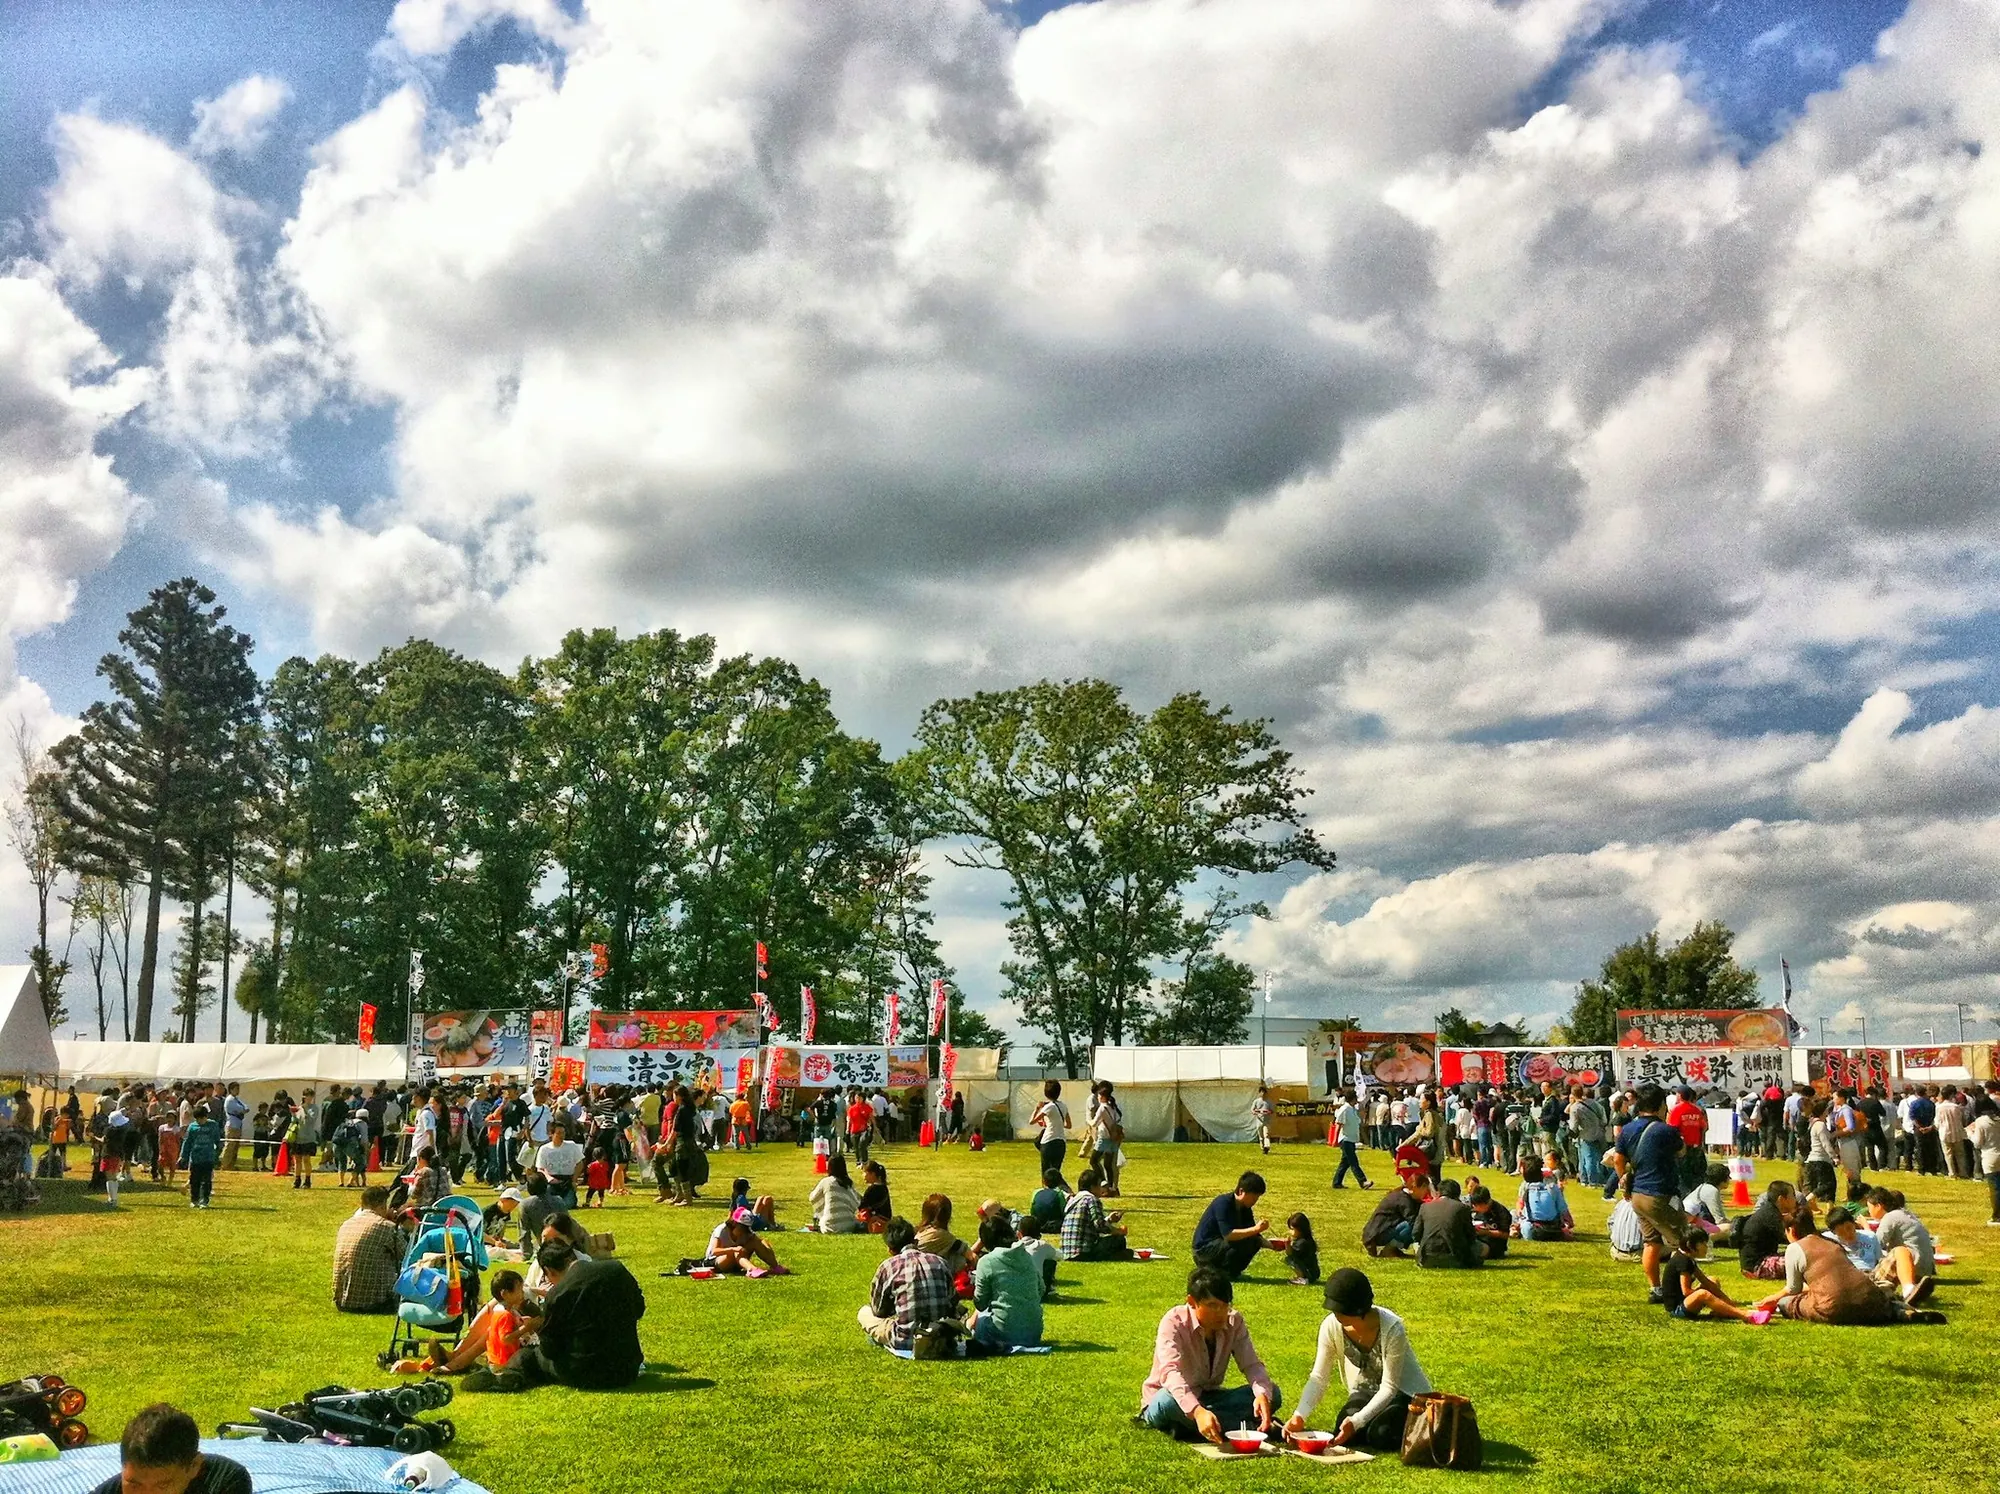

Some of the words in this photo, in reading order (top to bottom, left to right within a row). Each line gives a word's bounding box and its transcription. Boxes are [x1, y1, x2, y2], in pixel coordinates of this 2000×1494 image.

[505, 1011, 520, 1038] 富山
[1652, 1023, 1720, 1046] 真武咲弥
[1637, 1054, 1736, 1088] 真武咲弥
[1742, 1054, 1783, 1071] 札幌味噌
[1743, 1072, 1783, 1089] らーめん
